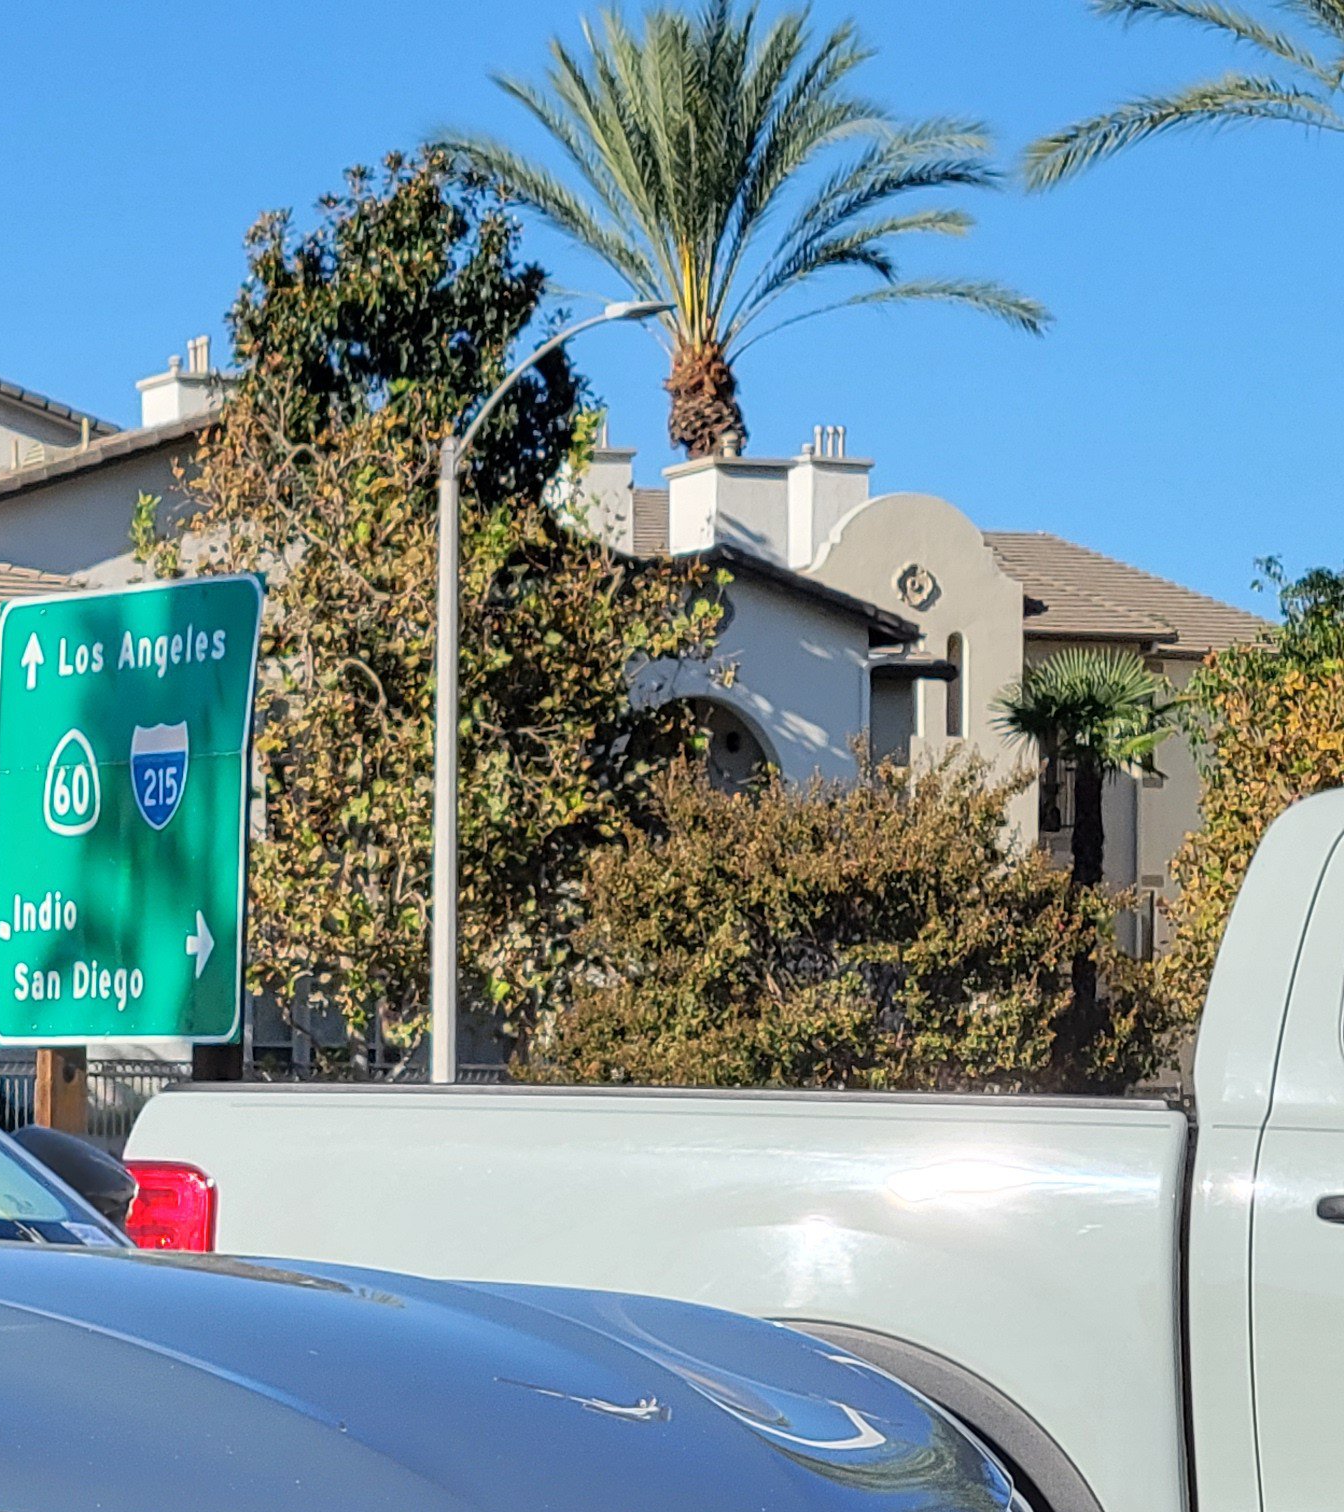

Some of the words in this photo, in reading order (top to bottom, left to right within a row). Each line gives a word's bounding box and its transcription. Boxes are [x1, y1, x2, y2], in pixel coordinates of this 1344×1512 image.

[59, 637, 104, 676] Los
[118, 623, 226, 678] Angeles
[53, 764, 90, 816] 60
[144, 767, 178, 807] 215
[13, 890, 77, 932] Indio
[14, 962, 61, 1001] San
[73, 960, 144, 1011] Diego
